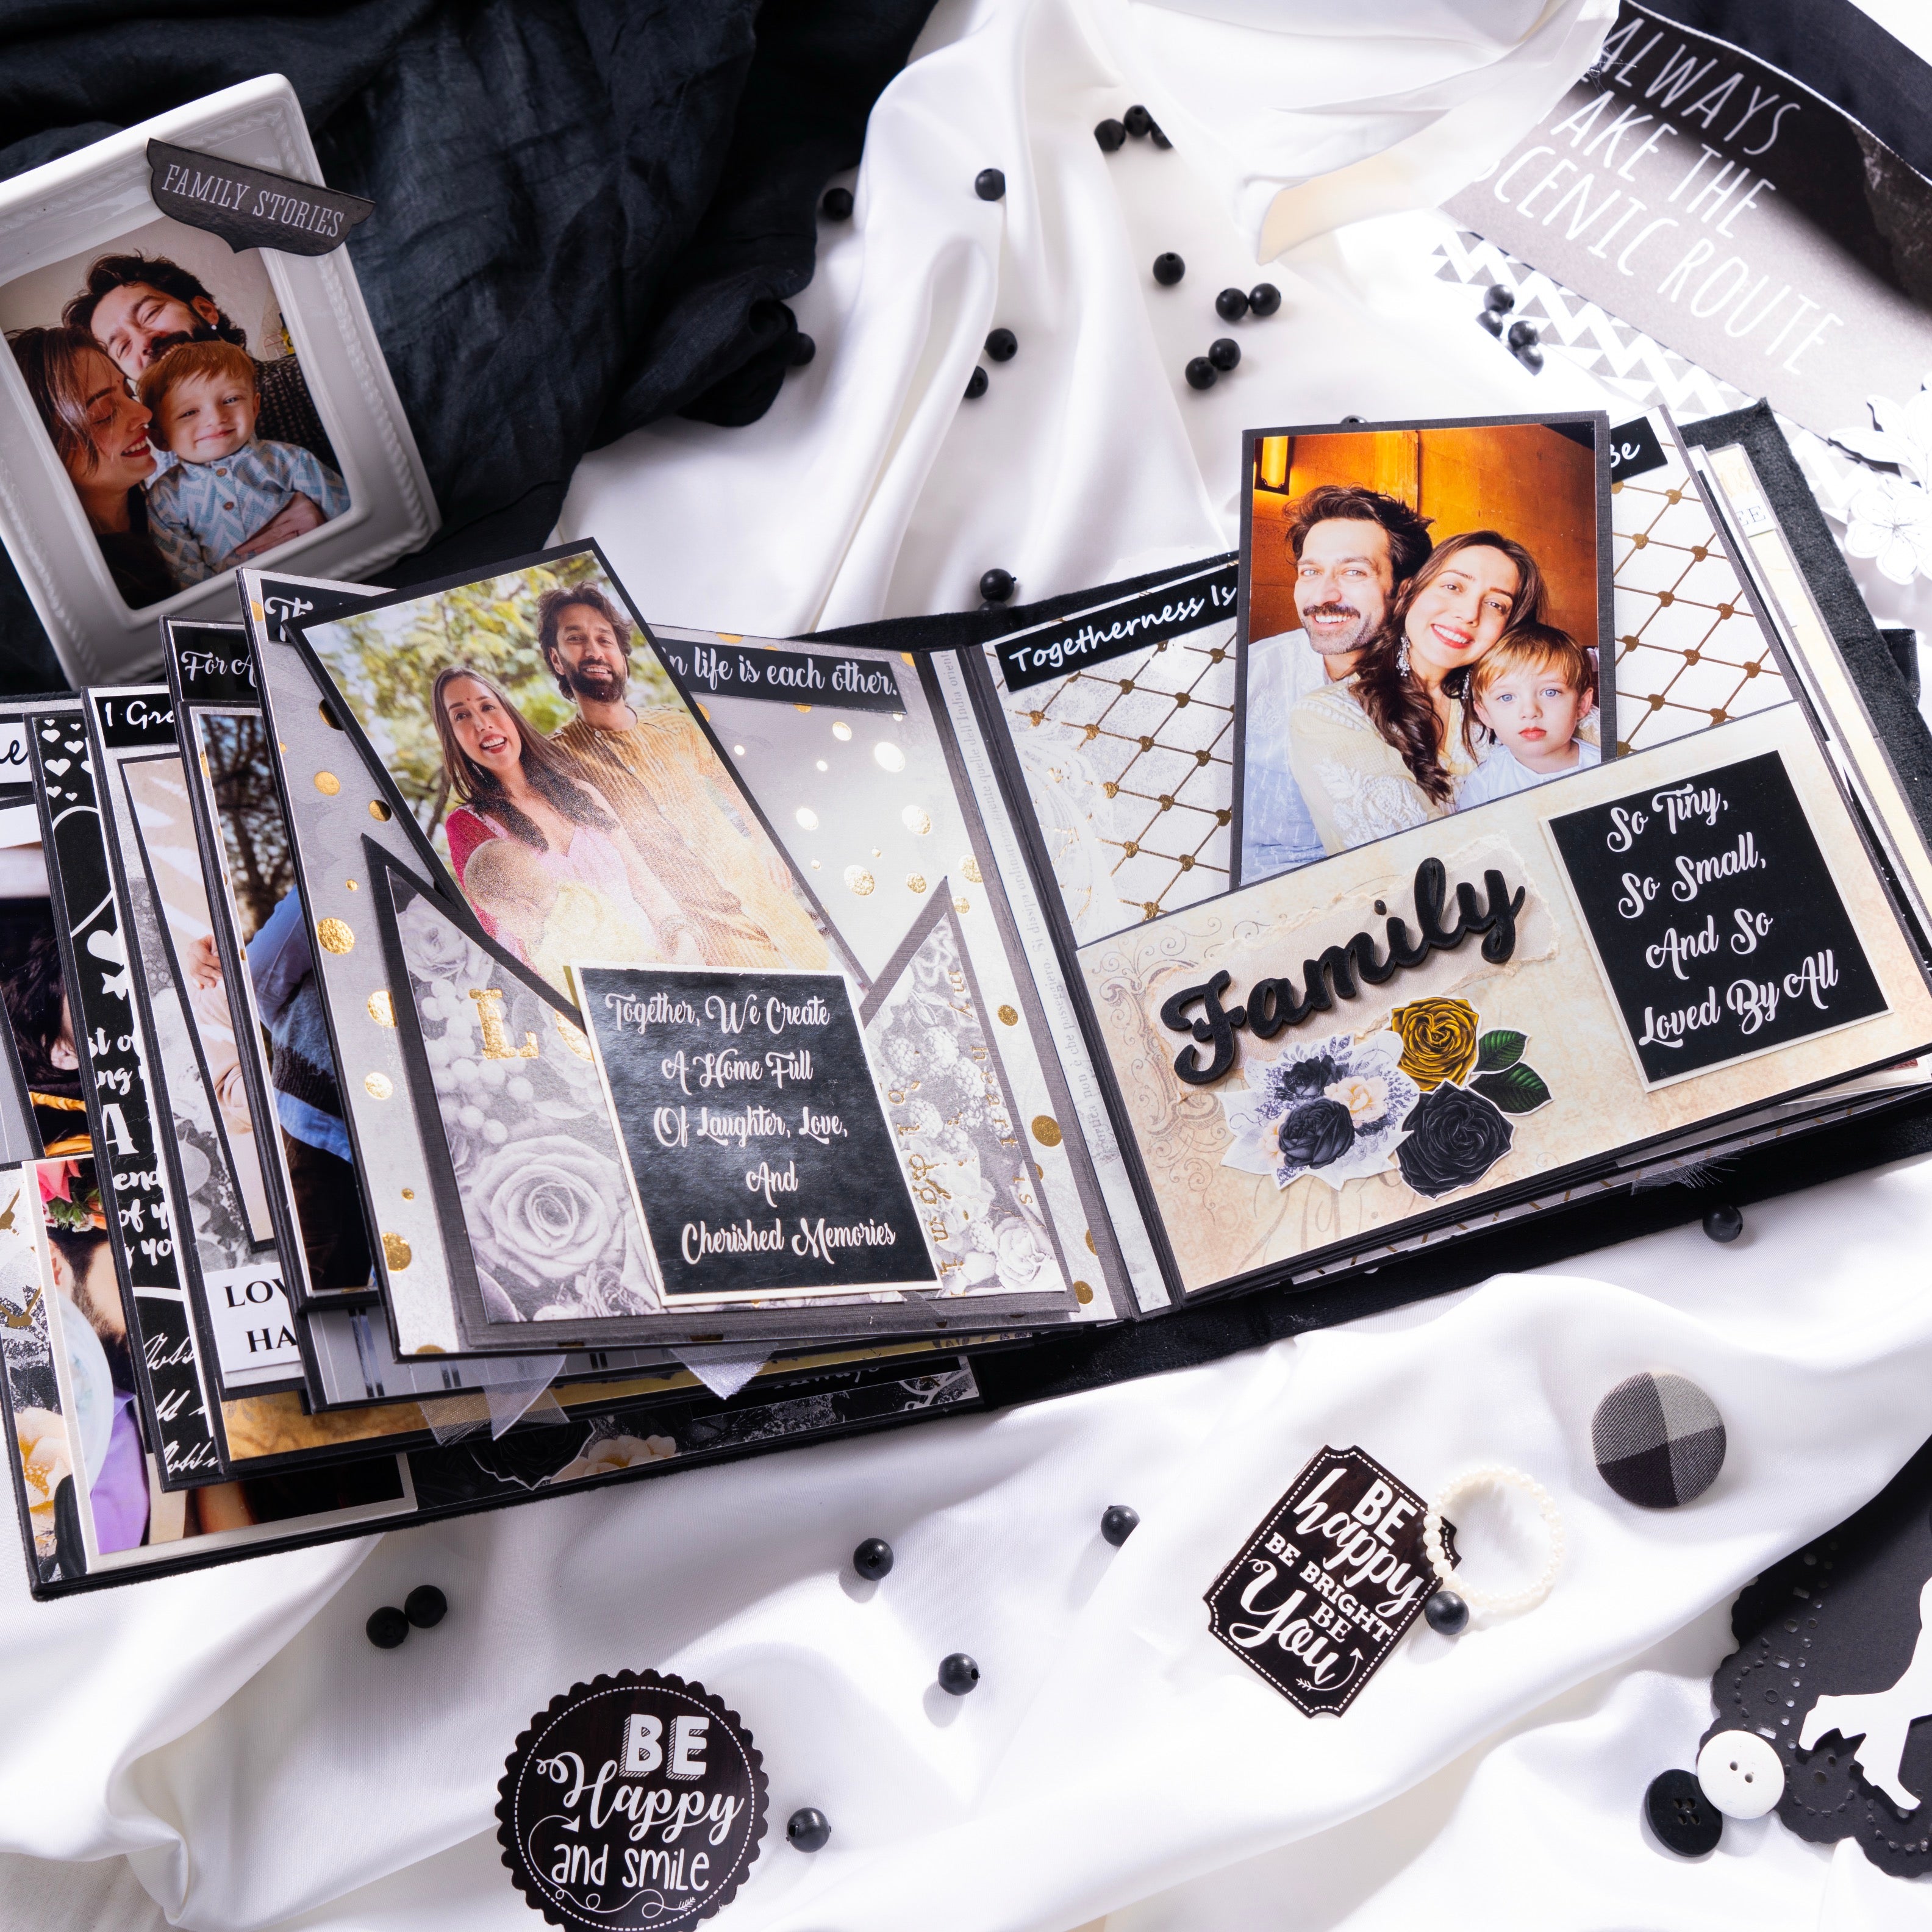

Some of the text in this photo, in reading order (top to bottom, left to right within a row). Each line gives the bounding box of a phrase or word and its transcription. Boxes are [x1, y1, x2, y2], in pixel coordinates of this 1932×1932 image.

[1597, 17, 1801, 155] ALWAYS
[1538, 79, 1776, 238] AKE THE
[161, 163, 345, 238] FAMILY STORIES
[1475, 145, 1844, 376] CENIC ROUTE
[1009, 584, 1237, 673] Togetherness Is
[181, 651, 228, 681] For
[695, 646, 733, 690] life
[739, 655, 760, 683] is
[767, 657, 825, 690] each
[831, 661, 897, 696] other.
[105, 702, 113, 727] I
[1607, 782, 1728, 853] So Tiny,
[1618, 831, 1766, 919] So Small,
[1160, 856, 1527, 1085] Family
[1645, 909, 1773, 980] And So
[605, 992, 831, 1037] Together, We Create
[1638, 949, 1840, 1048] Loved By All
[662, 1048, 814, 1096] A Home Full
[653, 1104, 848, 1148] Of Laughter, Love,
[746, 1160, 798, 1208] And
[681, 1218, 897, 1265] Cherished Memories
[1295, 1468, 1424, 1614] happy
[1351, 1479, 1417, 1546] BE
[1229, 1557, 1339, 1685] You
[1265, 1531, 1395, 1643] BE BRIGHT
[1310, 1601, 1351, 1642] BE
[619, 1714, 709, 1781] BE
[537, 1751, 745, 1845] Happy
[551, 1843, 609, 1888] and
